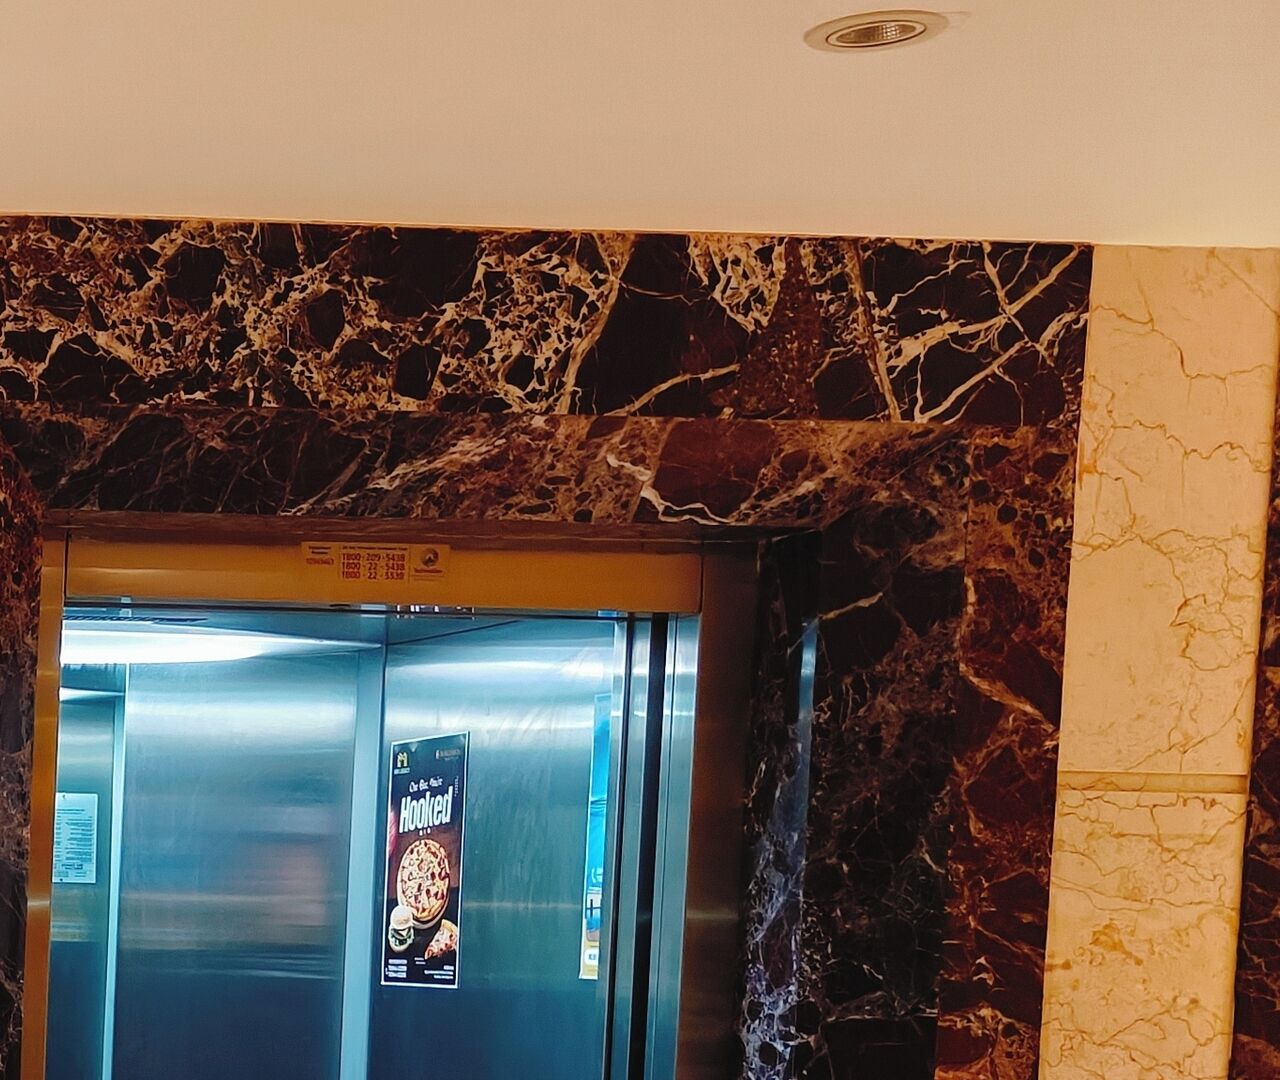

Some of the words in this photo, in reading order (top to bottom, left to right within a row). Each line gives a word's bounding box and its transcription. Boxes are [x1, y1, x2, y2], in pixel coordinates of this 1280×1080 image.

[342, 553, 361, 561] 1800
[366, 553, 381, 562] 209
[342, 562, 361, 570] 1800
[367, 562, 378, 570] 22
[385, 563, 405, 571] 5438
[342, 571, 360, 579] 1800
[367, 572, 377, 580] 22
[398, 785, 454, 834] Hooked
